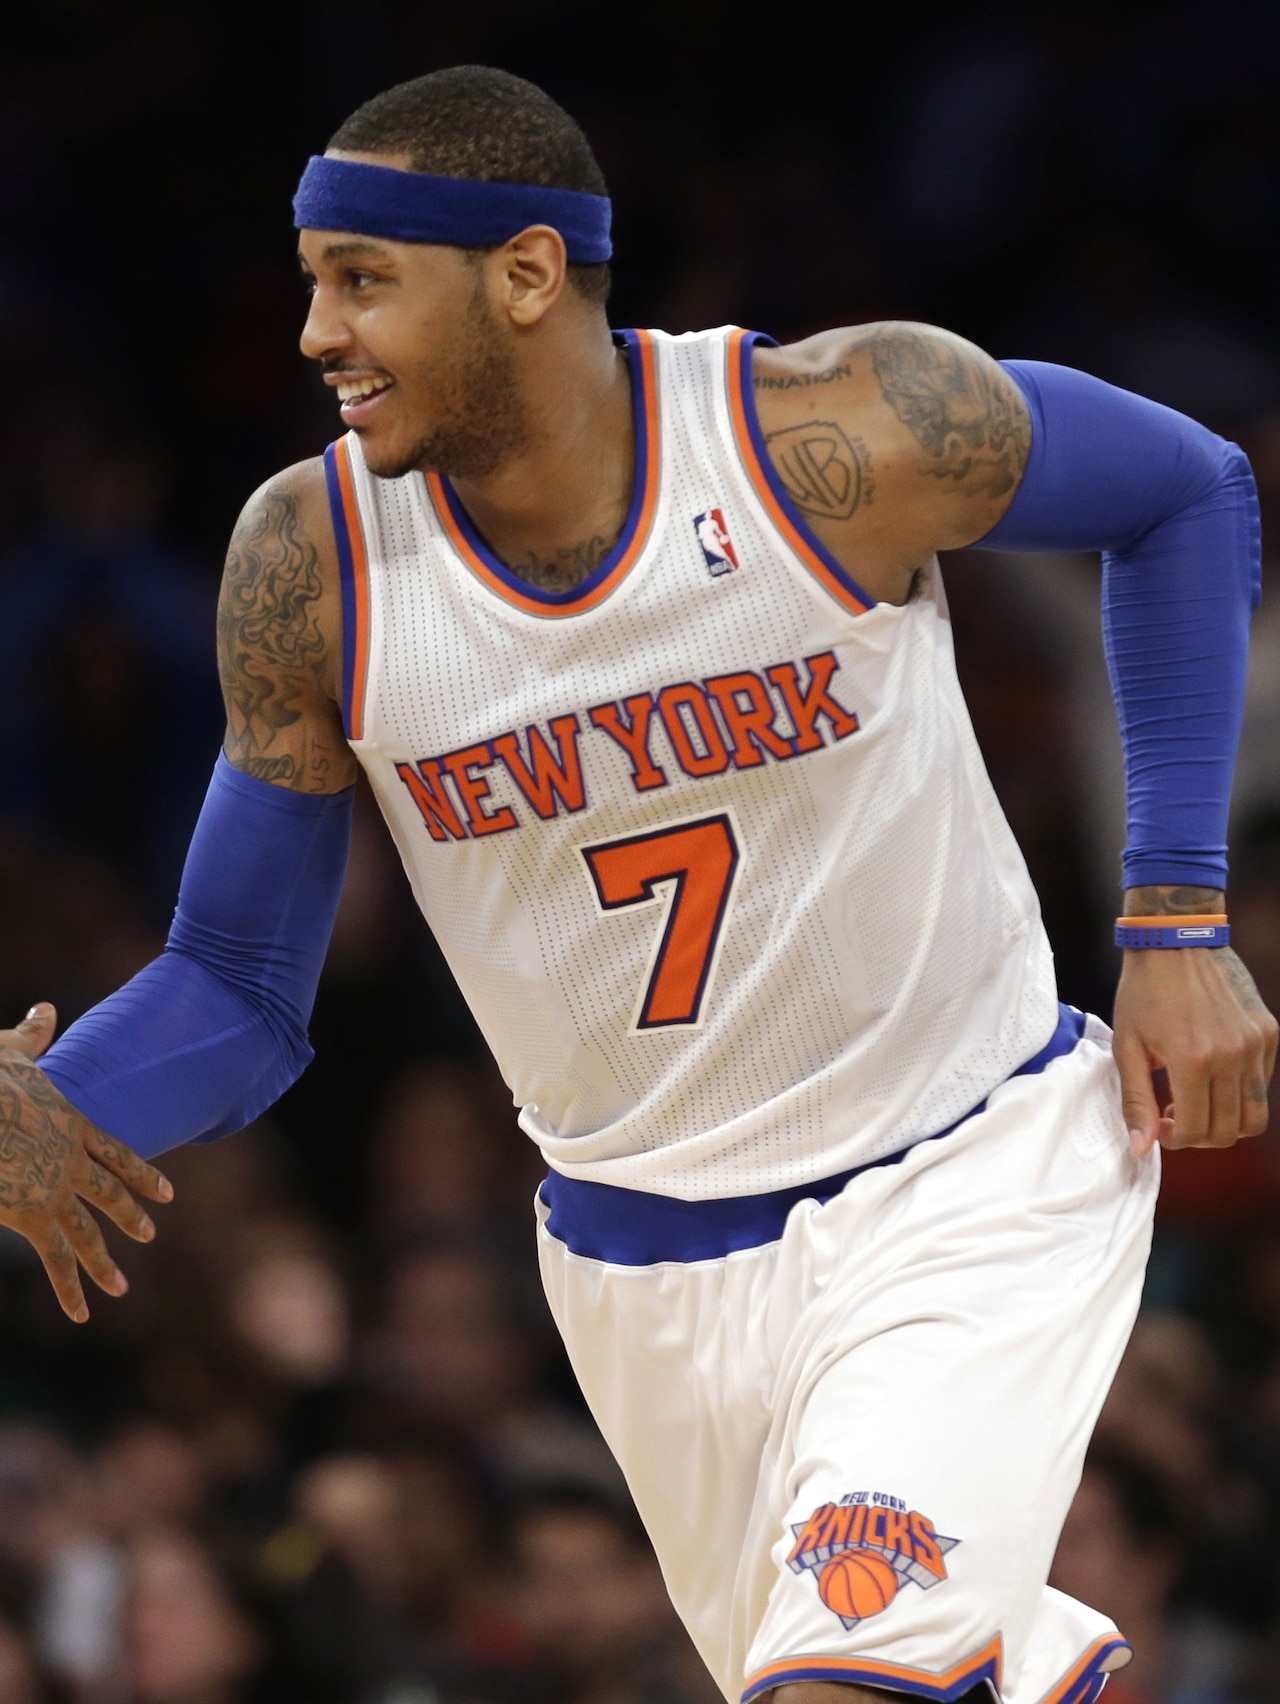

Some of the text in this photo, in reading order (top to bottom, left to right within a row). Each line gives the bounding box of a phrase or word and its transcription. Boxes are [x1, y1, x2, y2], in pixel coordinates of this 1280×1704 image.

[395, 650, 859, 842] NEW YORK
[581, 812, 741, 1030] 7
[786, 1502, 948, 1582] KNICKS
[839, 1491, 870, 1505] NEW
